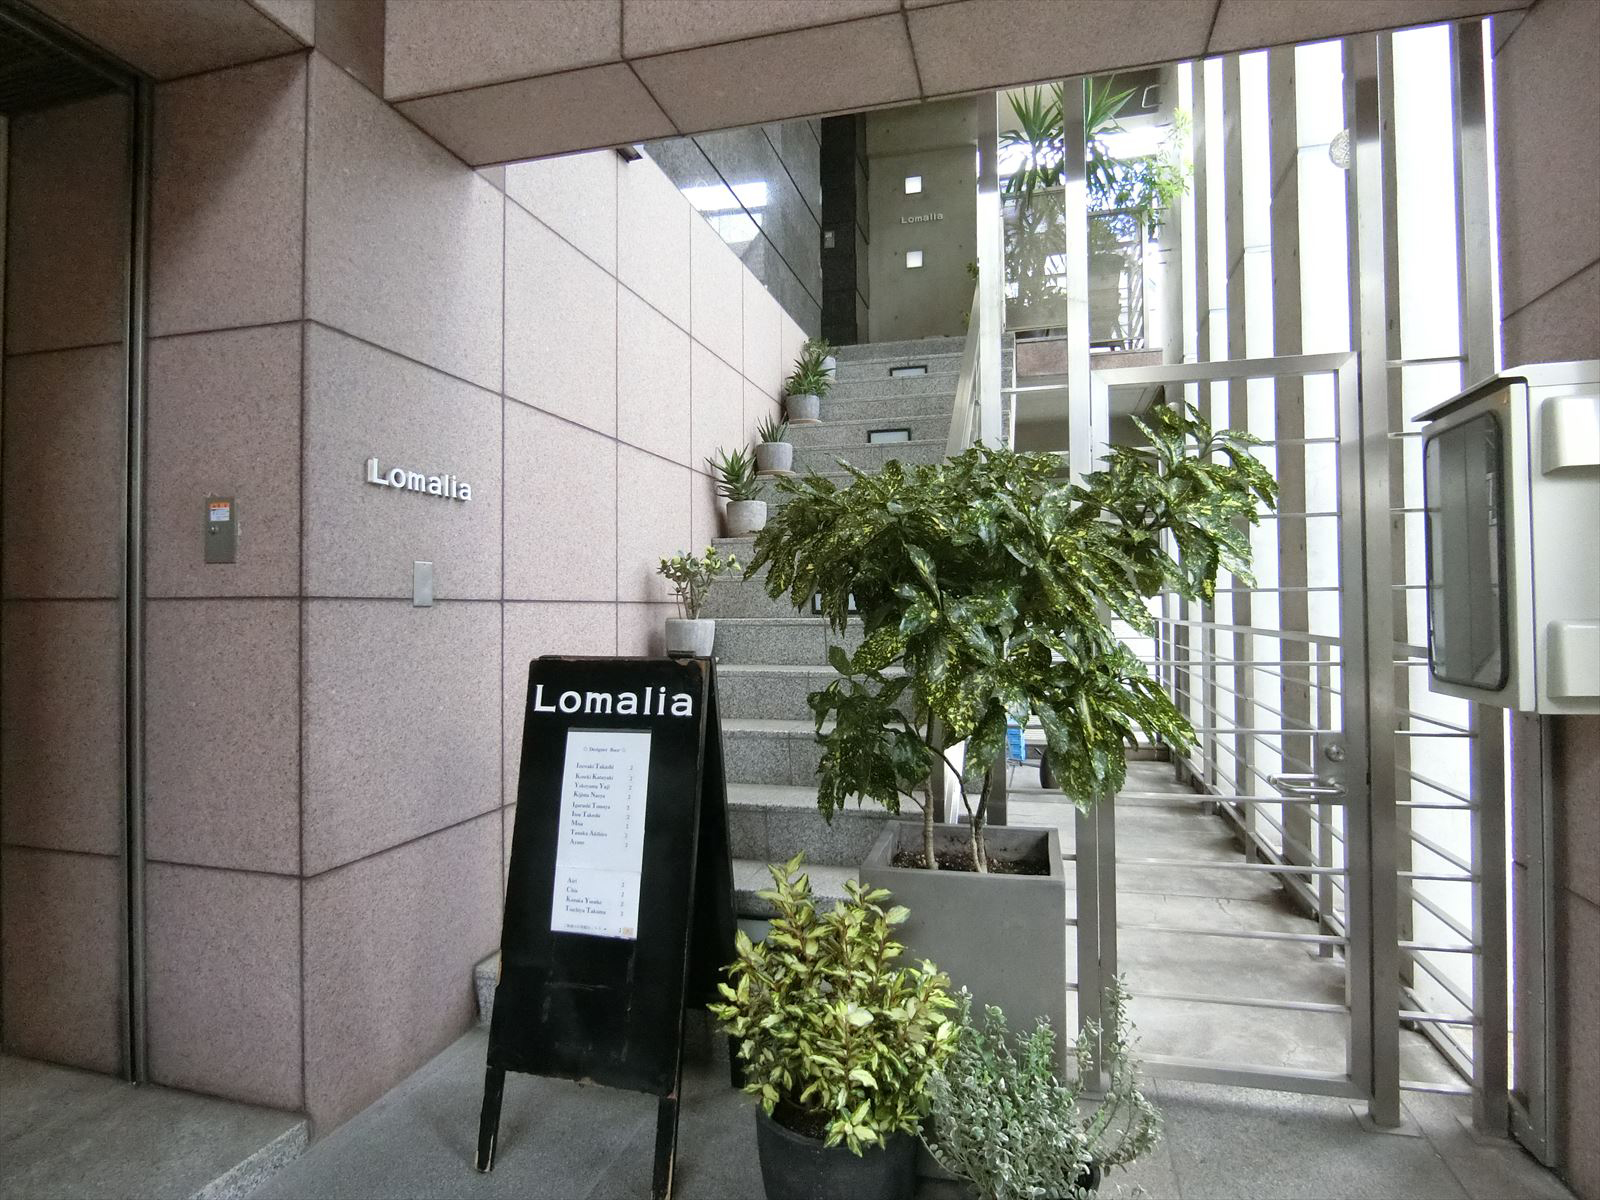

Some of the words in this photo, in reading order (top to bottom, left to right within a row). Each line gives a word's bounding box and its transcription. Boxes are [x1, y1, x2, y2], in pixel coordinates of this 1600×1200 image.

[901, 212, 944, 224] Lomalia
[367, 457, 472, 501] Lomalia
[534, 684, 693, 717] Lomalia
